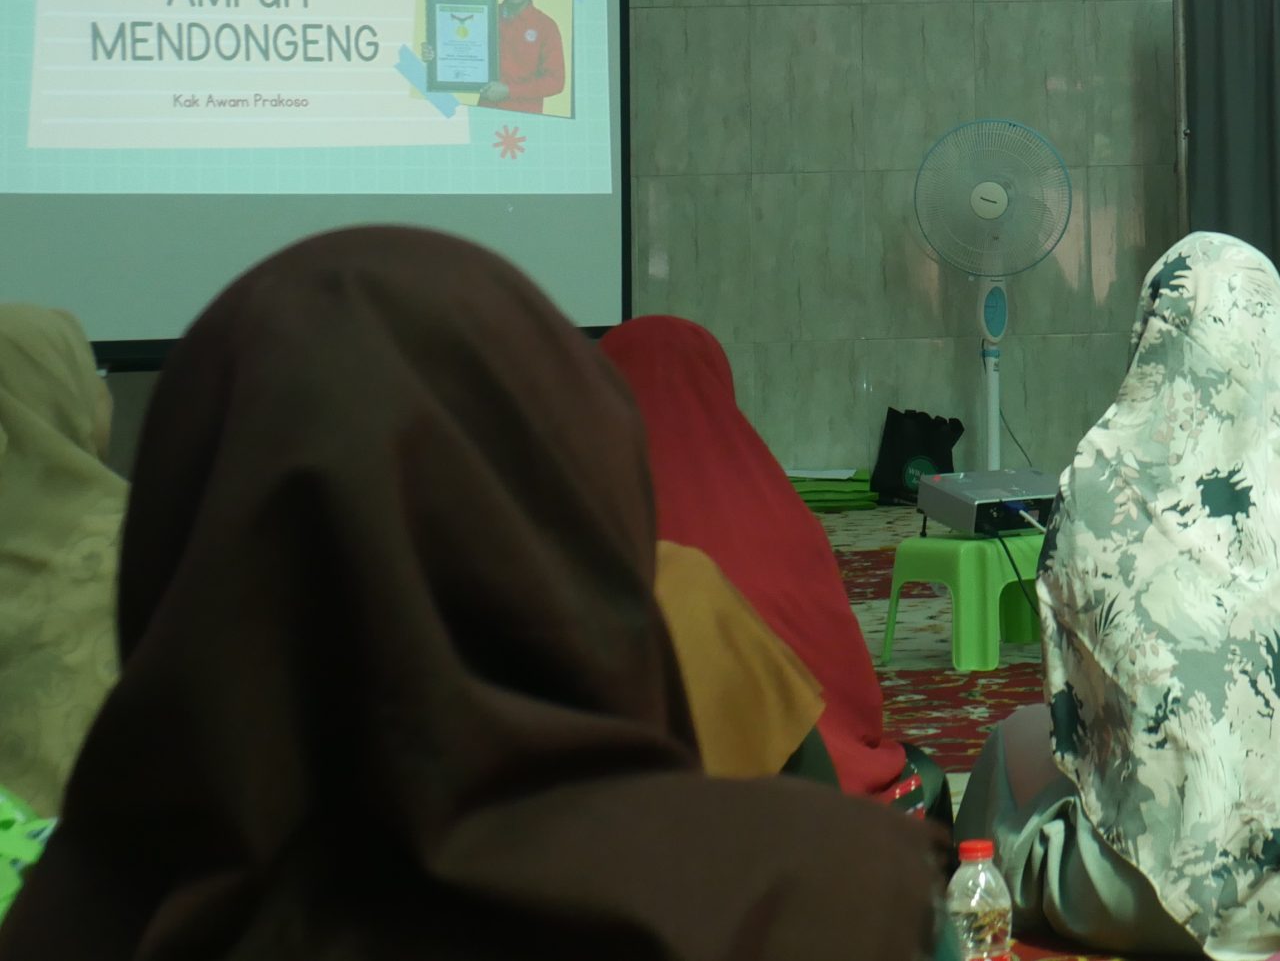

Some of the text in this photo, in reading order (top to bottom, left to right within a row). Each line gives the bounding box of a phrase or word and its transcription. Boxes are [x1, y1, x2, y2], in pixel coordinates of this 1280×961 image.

[91, 21, 380, 63] MENDONGENG
[173, 94, 309, 108] Kak Awam Prakoso
